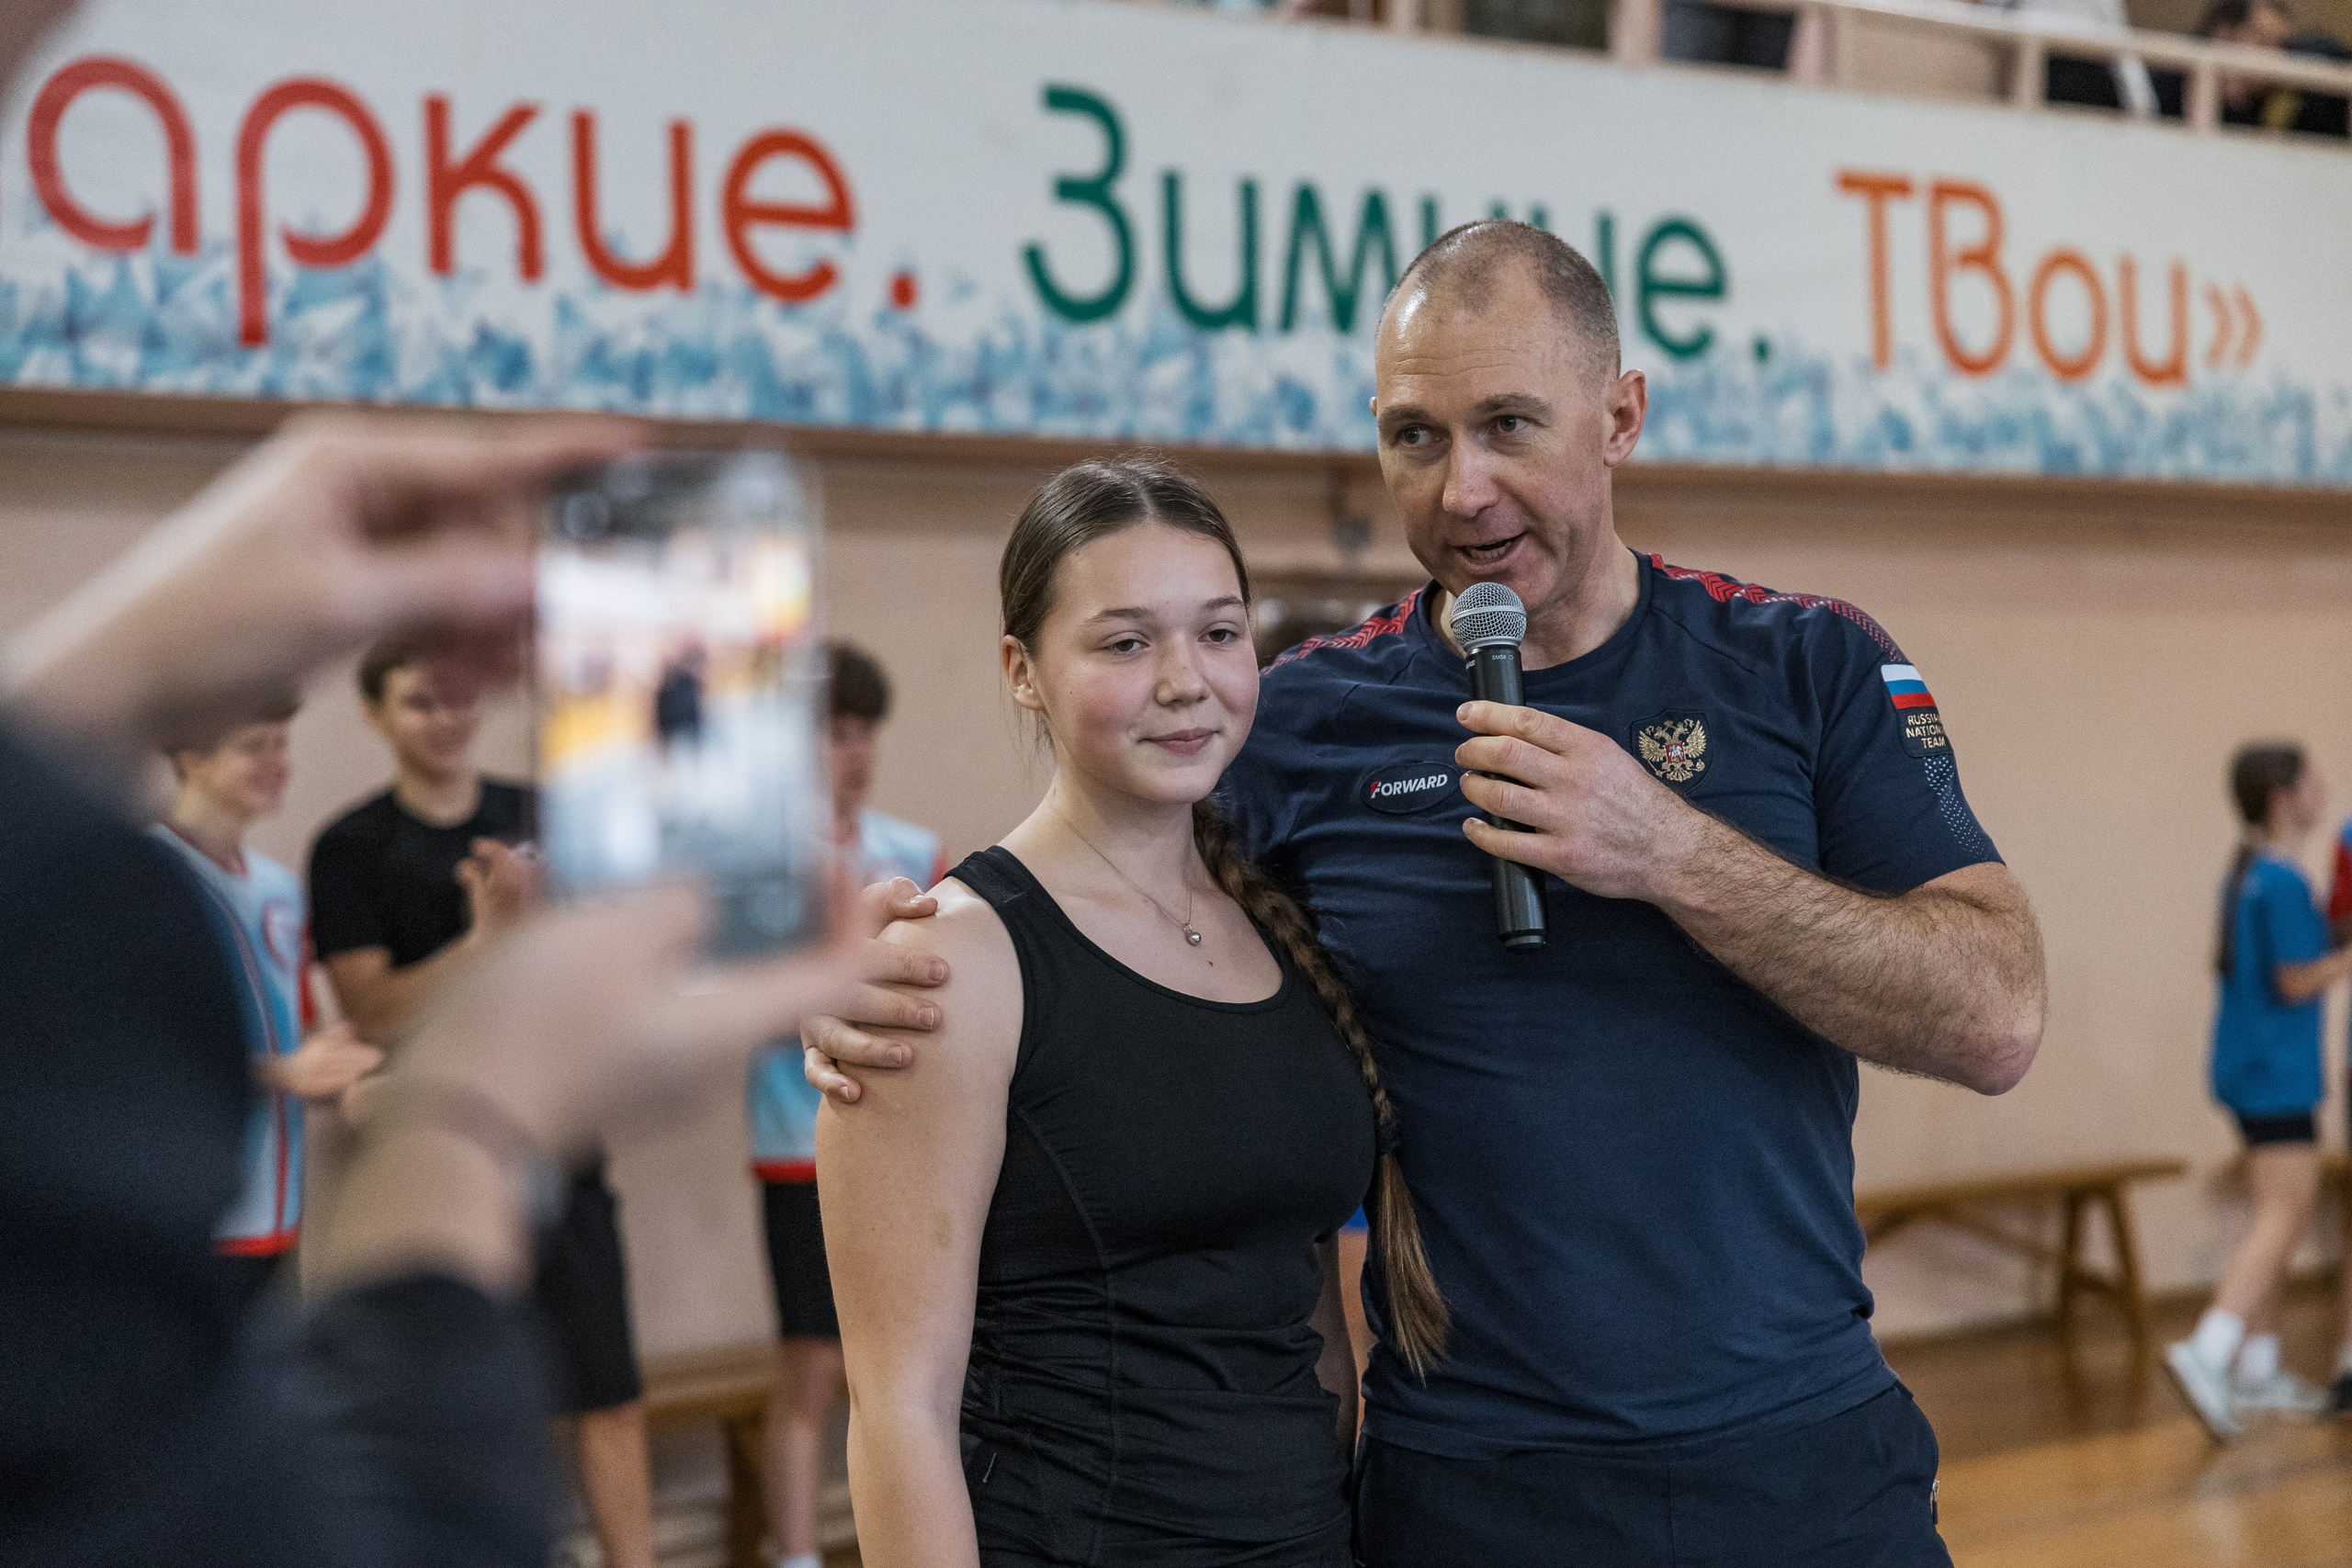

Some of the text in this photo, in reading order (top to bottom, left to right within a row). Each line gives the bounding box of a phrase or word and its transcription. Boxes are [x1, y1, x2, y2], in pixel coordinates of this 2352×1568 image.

[1022, 85, 1774, 366] Зиме.
[1905, 724, 1945, 739] NATION
[1921, 736, 1947, 749] TEAM
[1370, 773, 1448, 799] FORWARD
